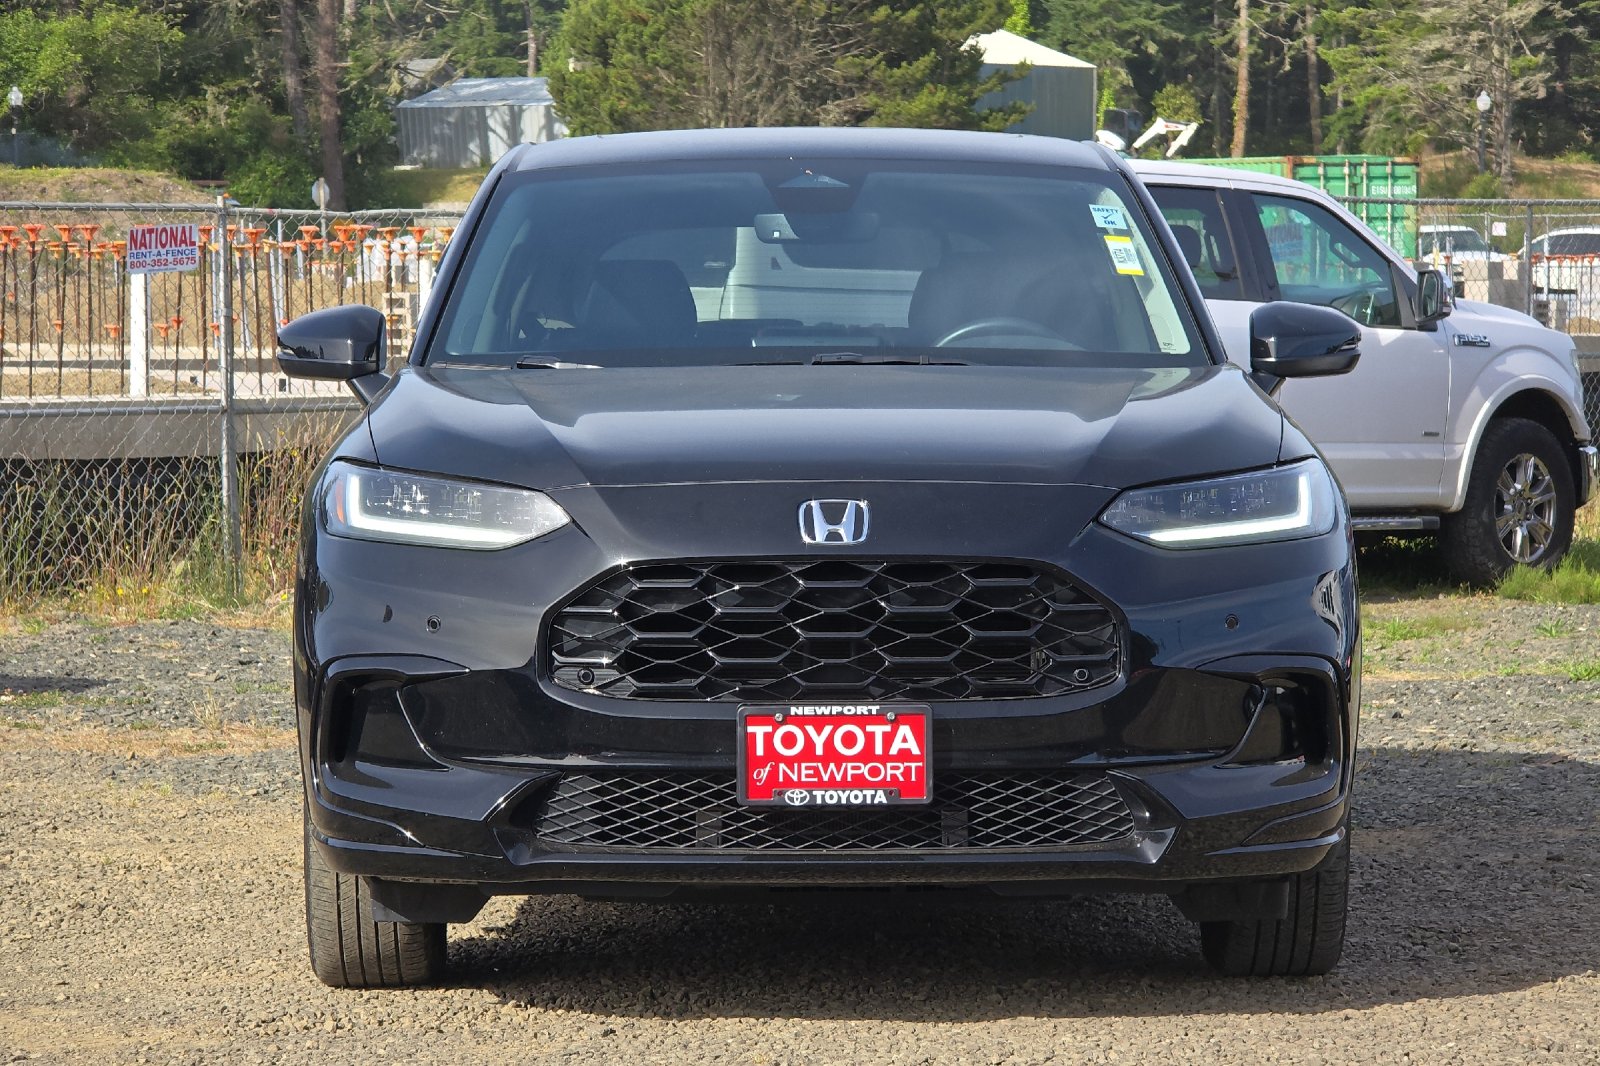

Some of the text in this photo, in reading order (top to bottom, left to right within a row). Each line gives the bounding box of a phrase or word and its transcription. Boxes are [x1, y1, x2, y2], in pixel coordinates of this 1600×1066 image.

[129, 225, 197, 251] NATIONAL
[129, 247, 197, 260] RENT-A-FENCE
[129, 257, 197, 269] 800-352-5675
[790, 705, 880, 715] NEWPORT
[747, 724, 921, 756] TOYOTA
[753, 762, 922, 786] of NEWPORT
[813, 789, 888, 804] TOYOTA
